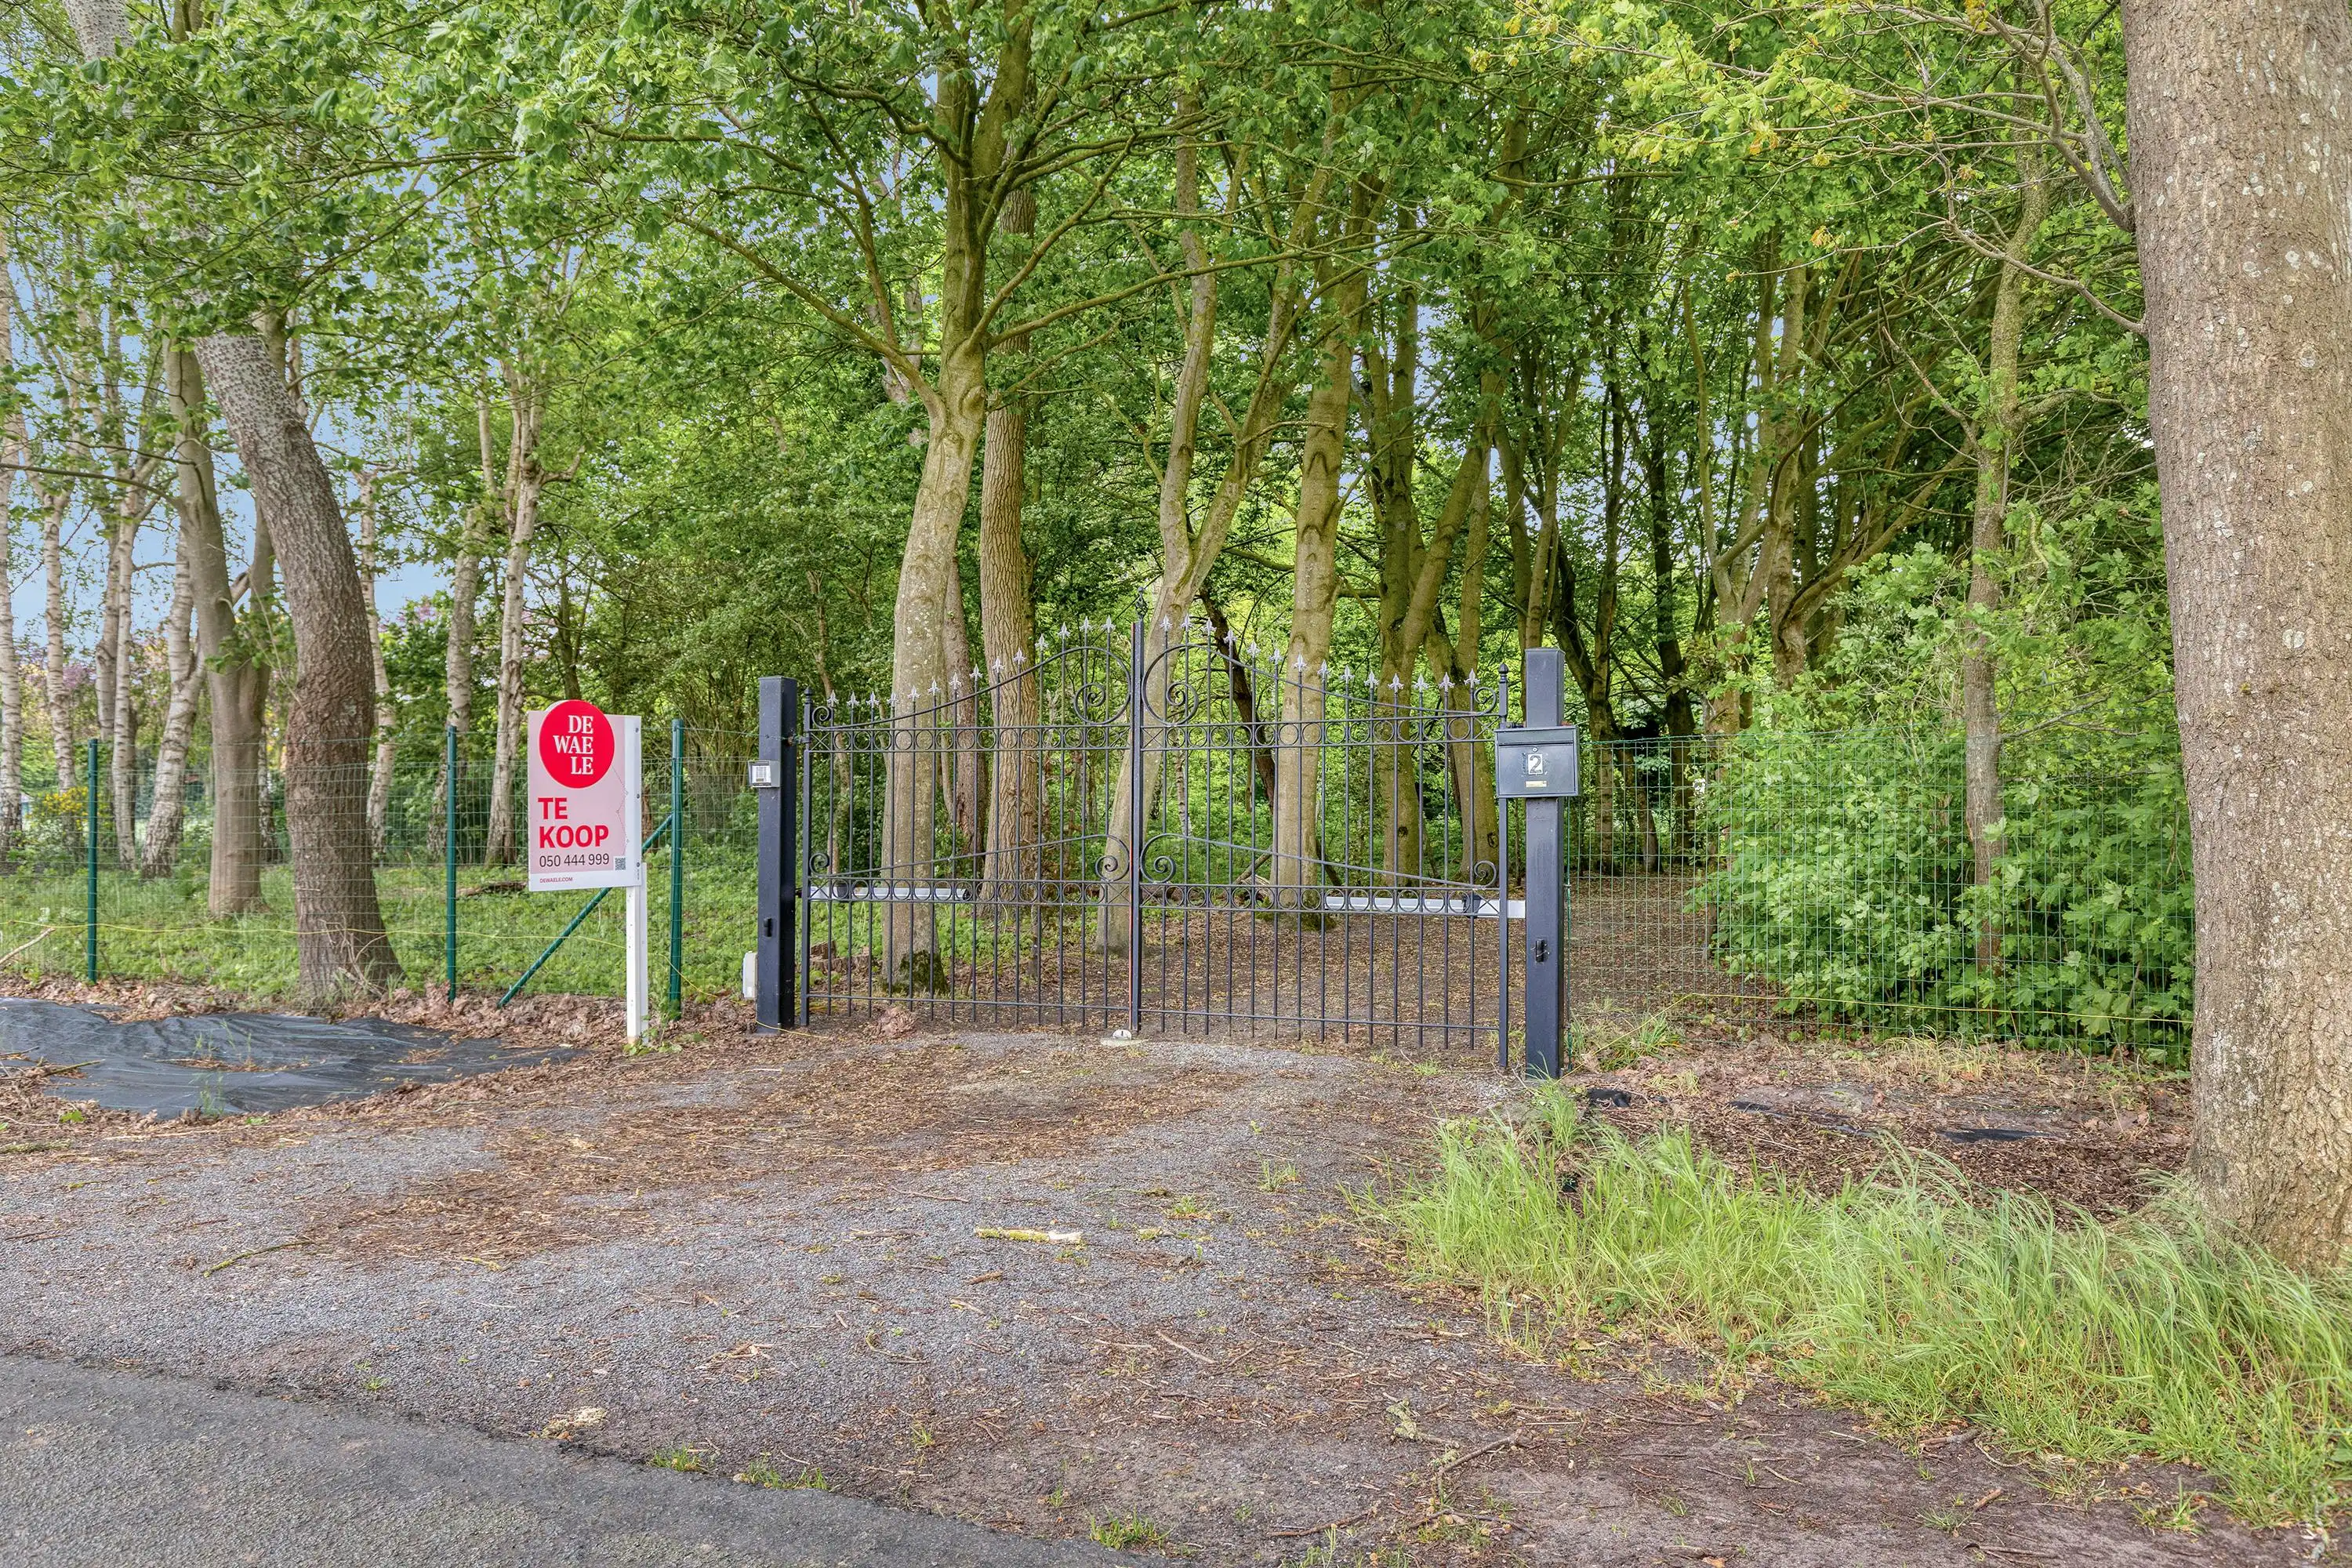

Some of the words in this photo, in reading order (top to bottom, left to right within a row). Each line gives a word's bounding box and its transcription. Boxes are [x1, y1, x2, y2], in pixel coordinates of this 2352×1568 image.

[568, 715, 593, 734] DE
[553, 735, 593, 755] WAE
[570, 757, 593, 775] LE
[1530, 754, 1542, 774] 2
[537, 797, 568, 820] TE
[539, 825, 609, 848] KOOP
[539, 855, 561, 867] 050
[564, 855, 586, 866] 444
[588, 853, 609, 866] 999
